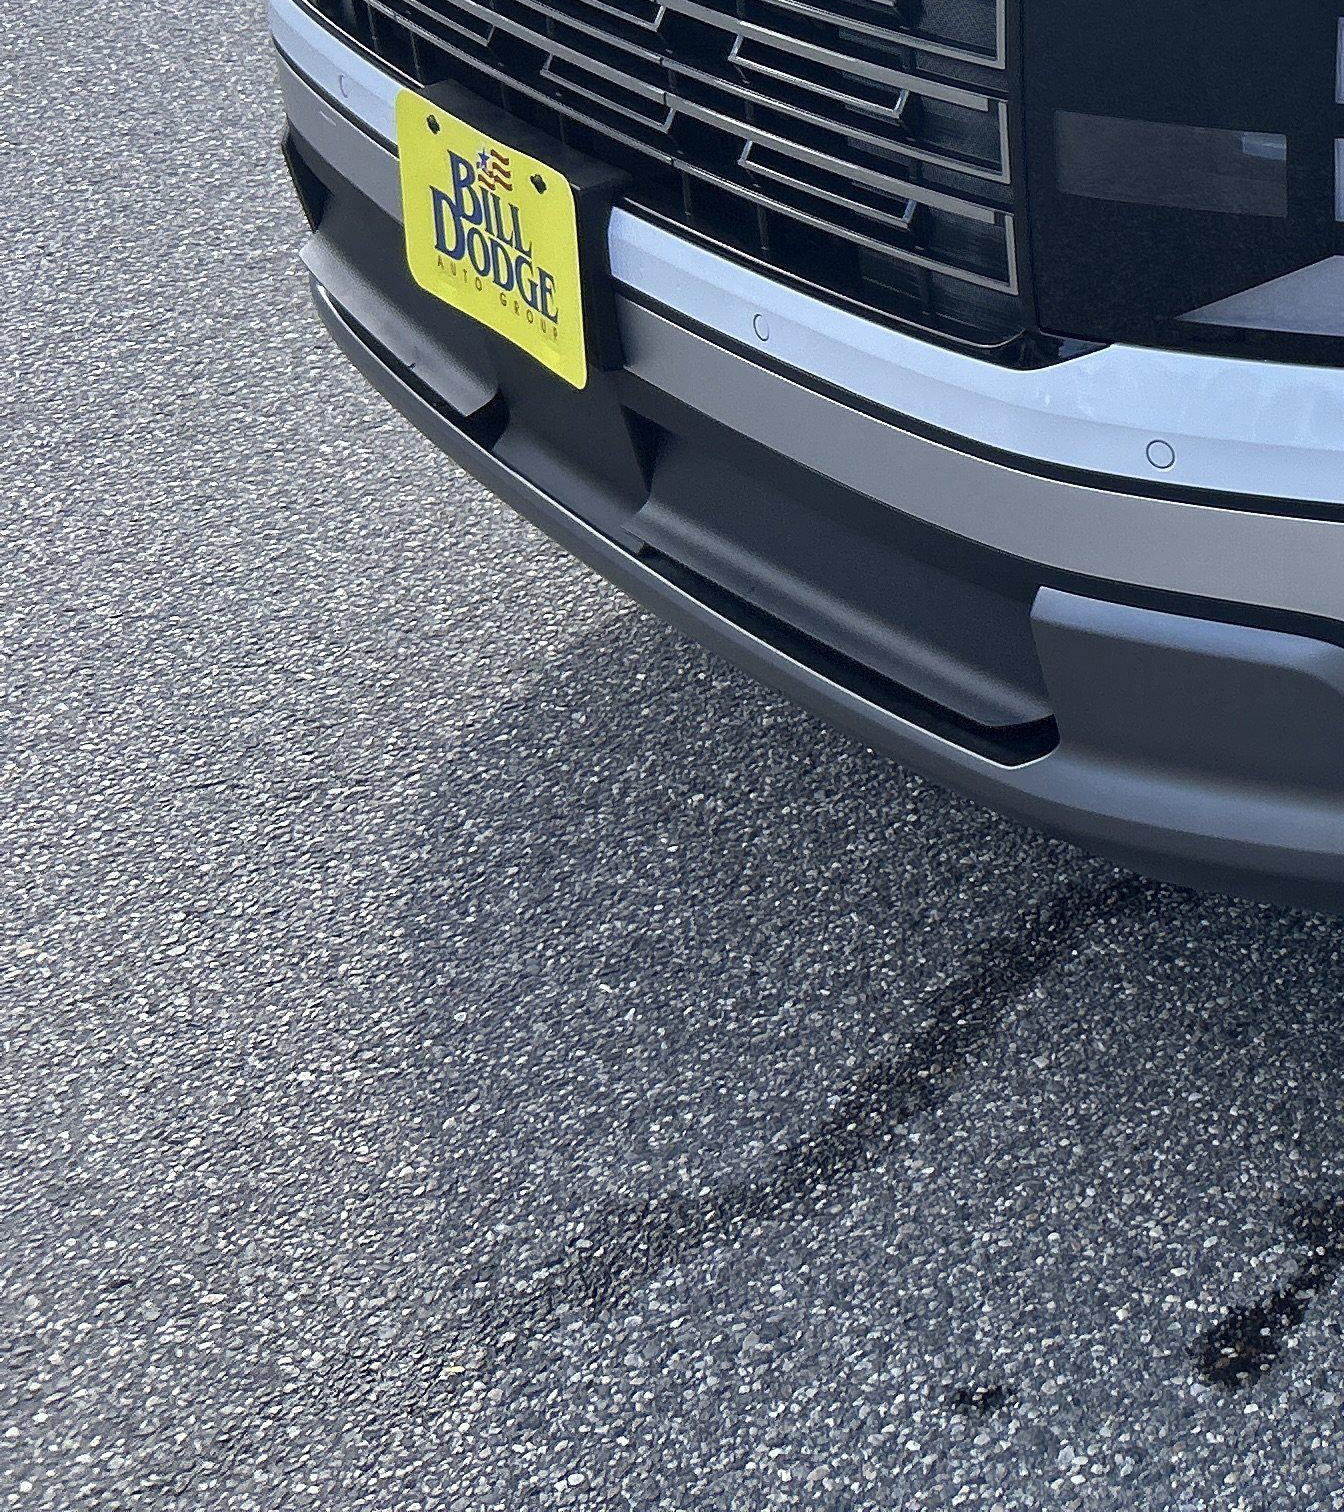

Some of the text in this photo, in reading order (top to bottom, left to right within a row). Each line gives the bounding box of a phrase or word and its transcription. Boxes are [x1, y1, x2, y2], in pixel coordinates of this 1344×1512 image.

[429, 184, 559, 325] DODGE
[447, 149, 532, 259] BILL
[437, 255, 559, 338] AUTO GROUP
